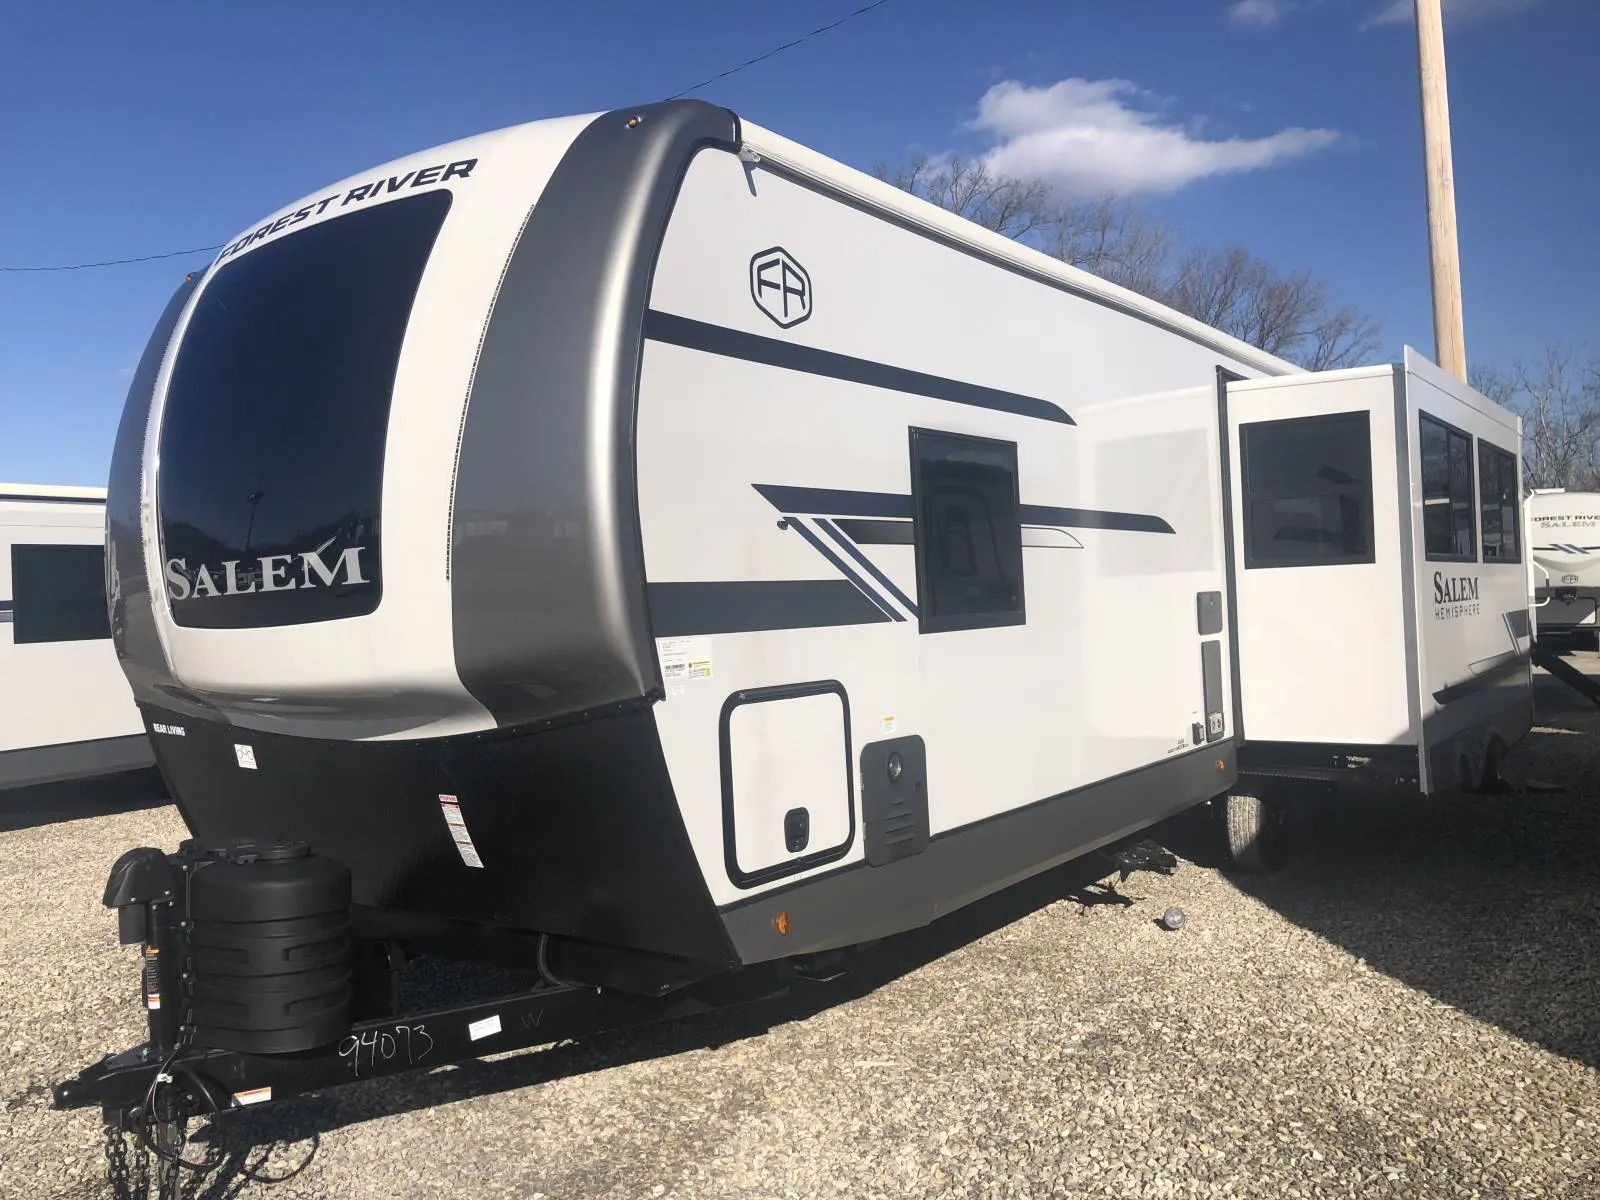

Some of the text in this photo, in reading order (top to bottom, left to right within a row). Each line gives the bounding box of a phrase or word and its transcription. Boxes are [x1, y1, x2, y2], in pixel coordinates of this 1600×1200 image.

[214, 157, 479, 266] FOREST RIVER
[1541, 521, 1596, 529] SALEM
[165, 545, 371, 601] SALEM
[1433, 570, 1480, 605] SALEM
[1434, 603, 1481, 621] HEMISPHERE
[152, 722, 186, 737] REAR LIVING
[337, 1024, 434, 1078] 94073
